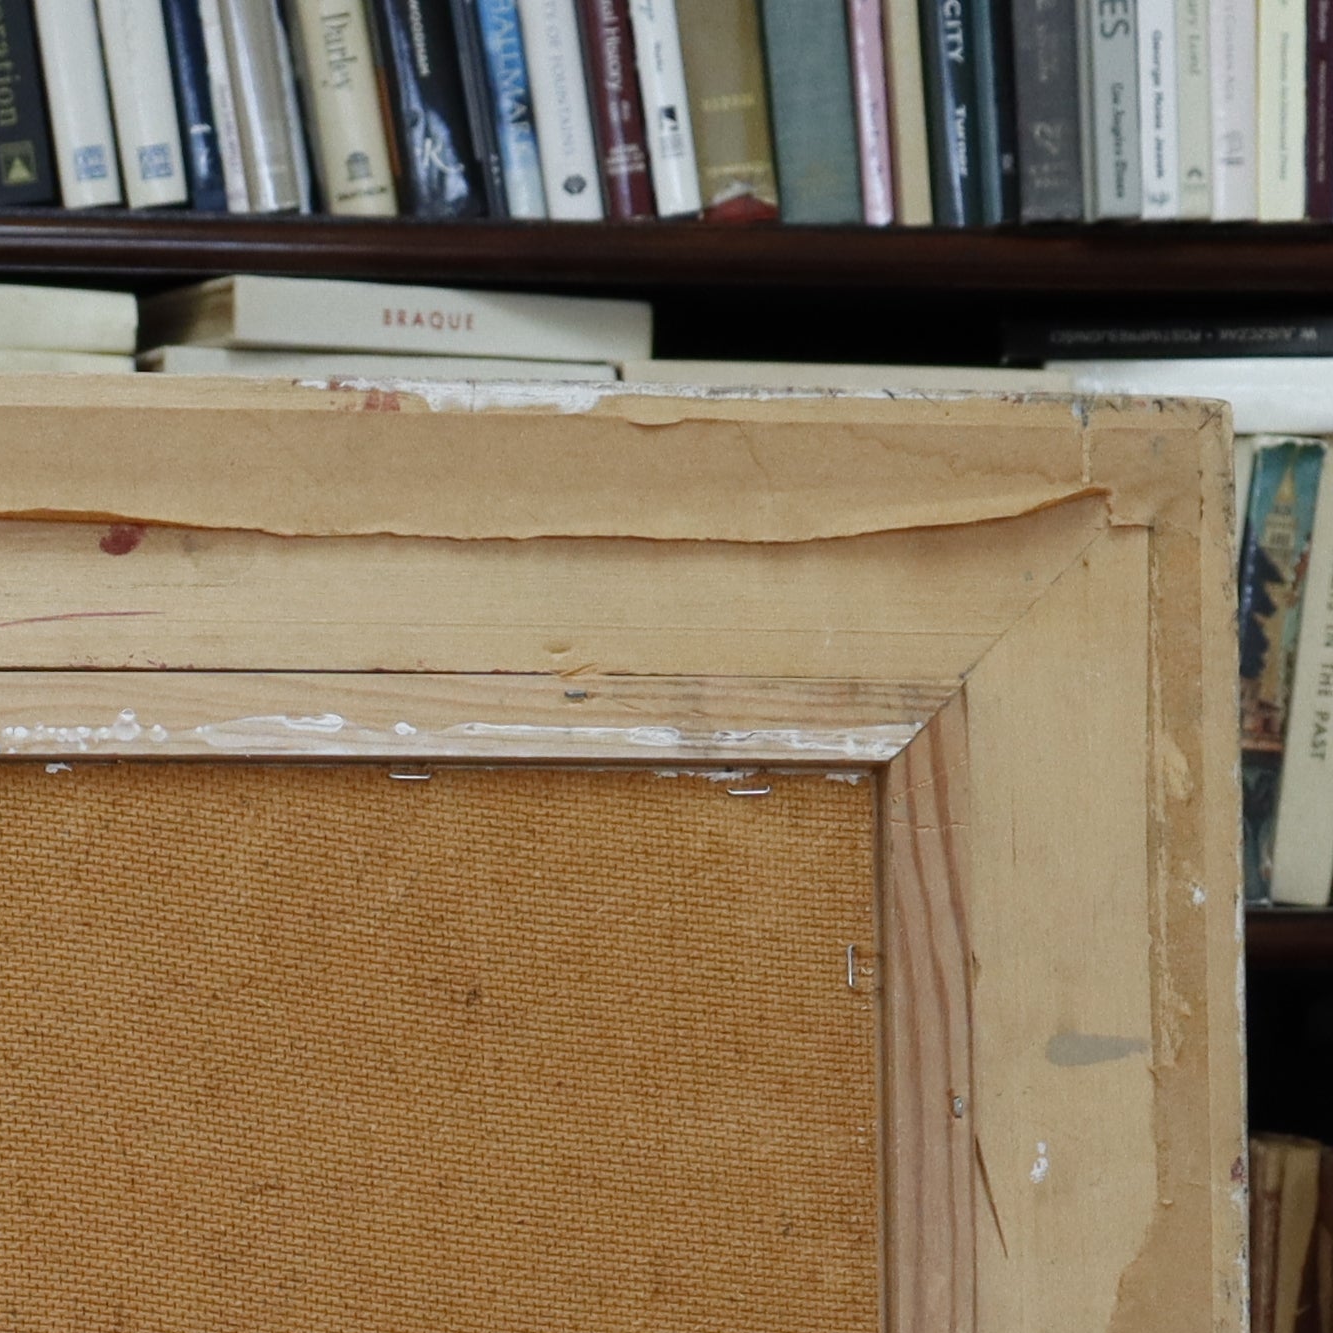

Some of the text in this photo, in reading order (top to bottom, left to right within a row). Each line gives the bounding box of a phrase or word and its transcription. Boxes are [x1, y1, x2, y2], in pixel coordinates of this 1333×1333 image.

[947, 0, 966, 64] CITY
[382, 308, 476, 331] BRAQUE
[1310, 707, 1331, 761] PAST
